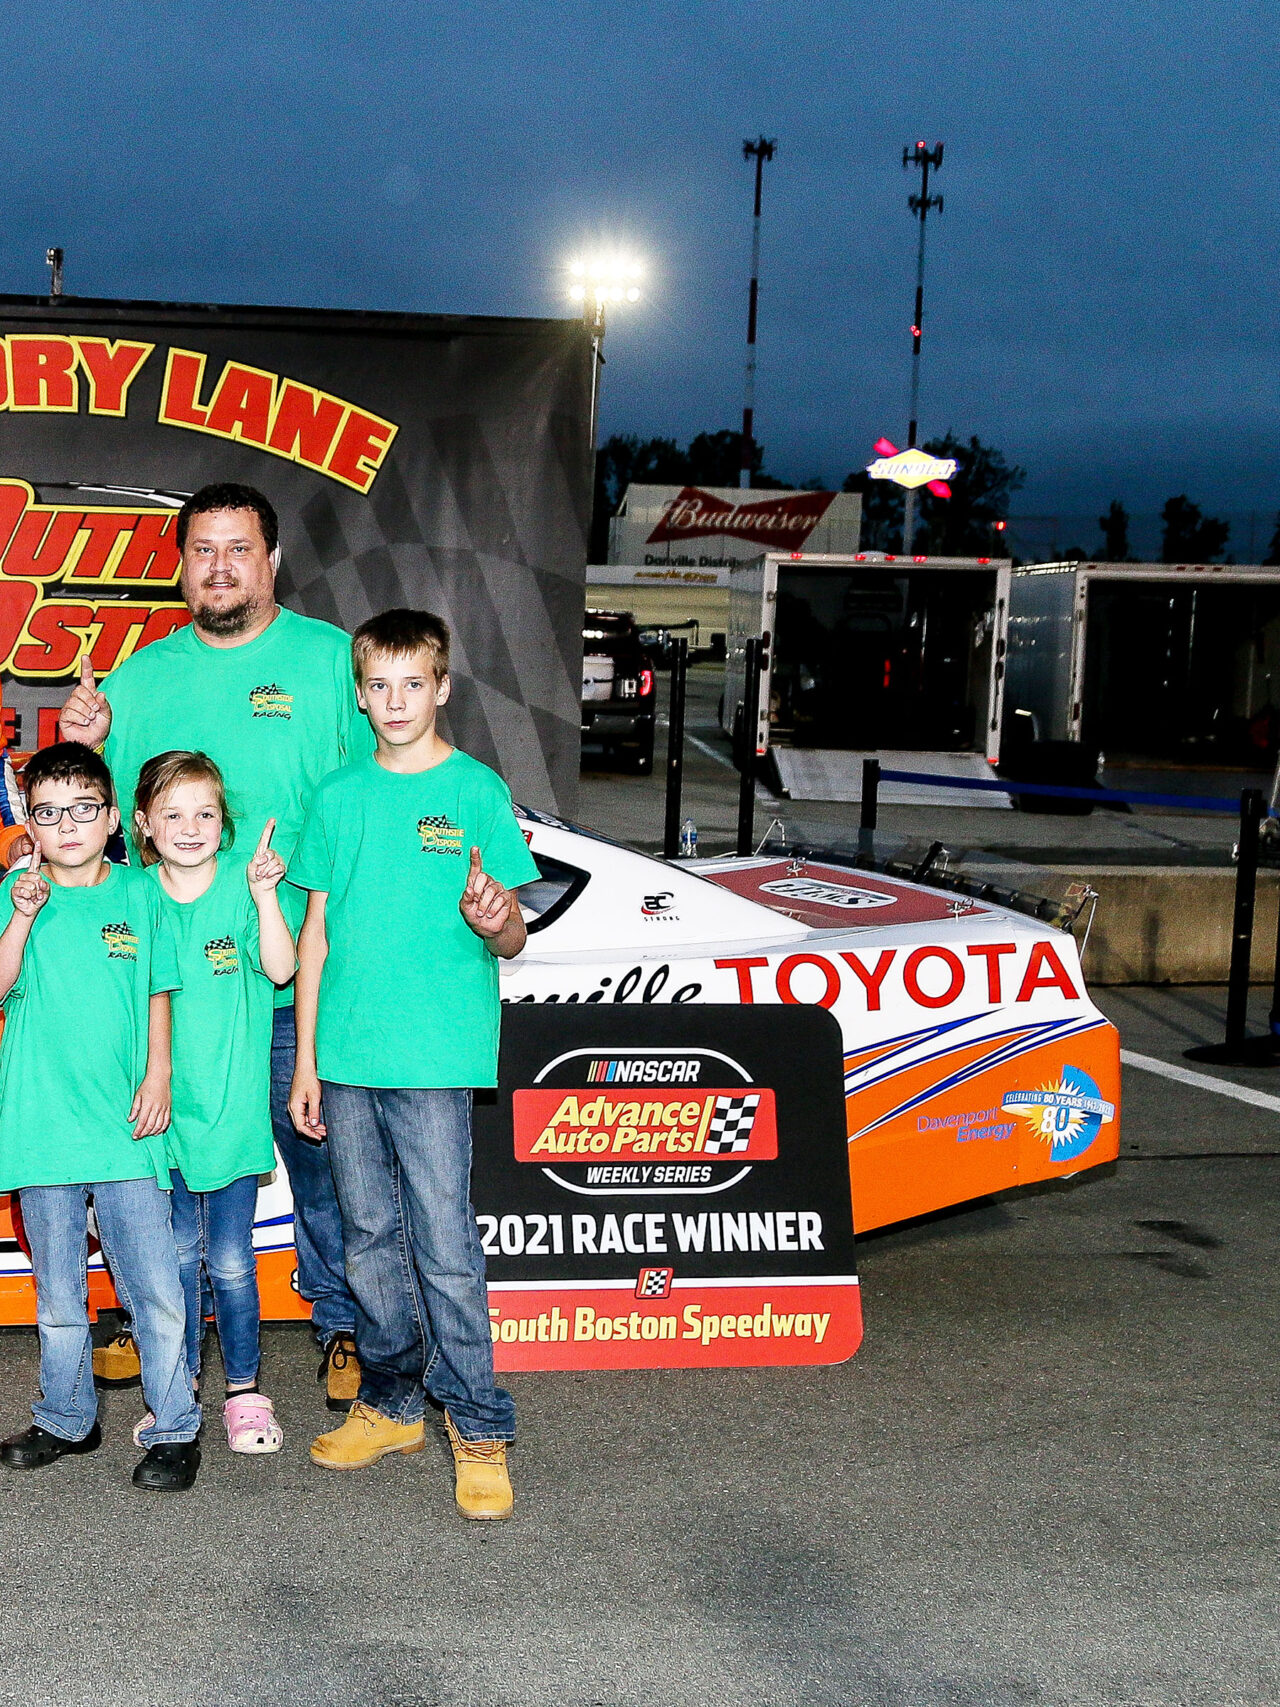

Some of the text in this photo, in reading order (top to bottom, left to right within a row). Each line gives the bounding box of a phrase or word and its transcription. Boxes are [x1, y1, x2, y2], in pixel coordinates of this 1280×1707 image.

[158, 347, 399, 494] LANE
[664, 499, 822, 530] Budweiser
[644, 554, 696, 567] Danville
[714, 941, 1080, 1012] TOYOTA
[614, 1061, 701, 1082] NASCAR
[548, 1096, 701, 1127] Advance
[1005, 1092, 1042, 1104] CELEBRATING
[1043, 1093, 1055, 1103] 80
[1056, 1095, 1082, 1107] YEARS
[917, 1106, 999, 1132] Davenport
[956, 1121, 1016, 1144] Energy
[1040, 1106, 1070, 1133] 80
[529, 1127, 694, 1154] Auto Parts
[586, 1166, 713, 1184] WEEKLY SERIES
[475, 1211, 825, 1256] 2021 RACE WINNER
[489, 1302, 831, 1346] South Boston Speedway
